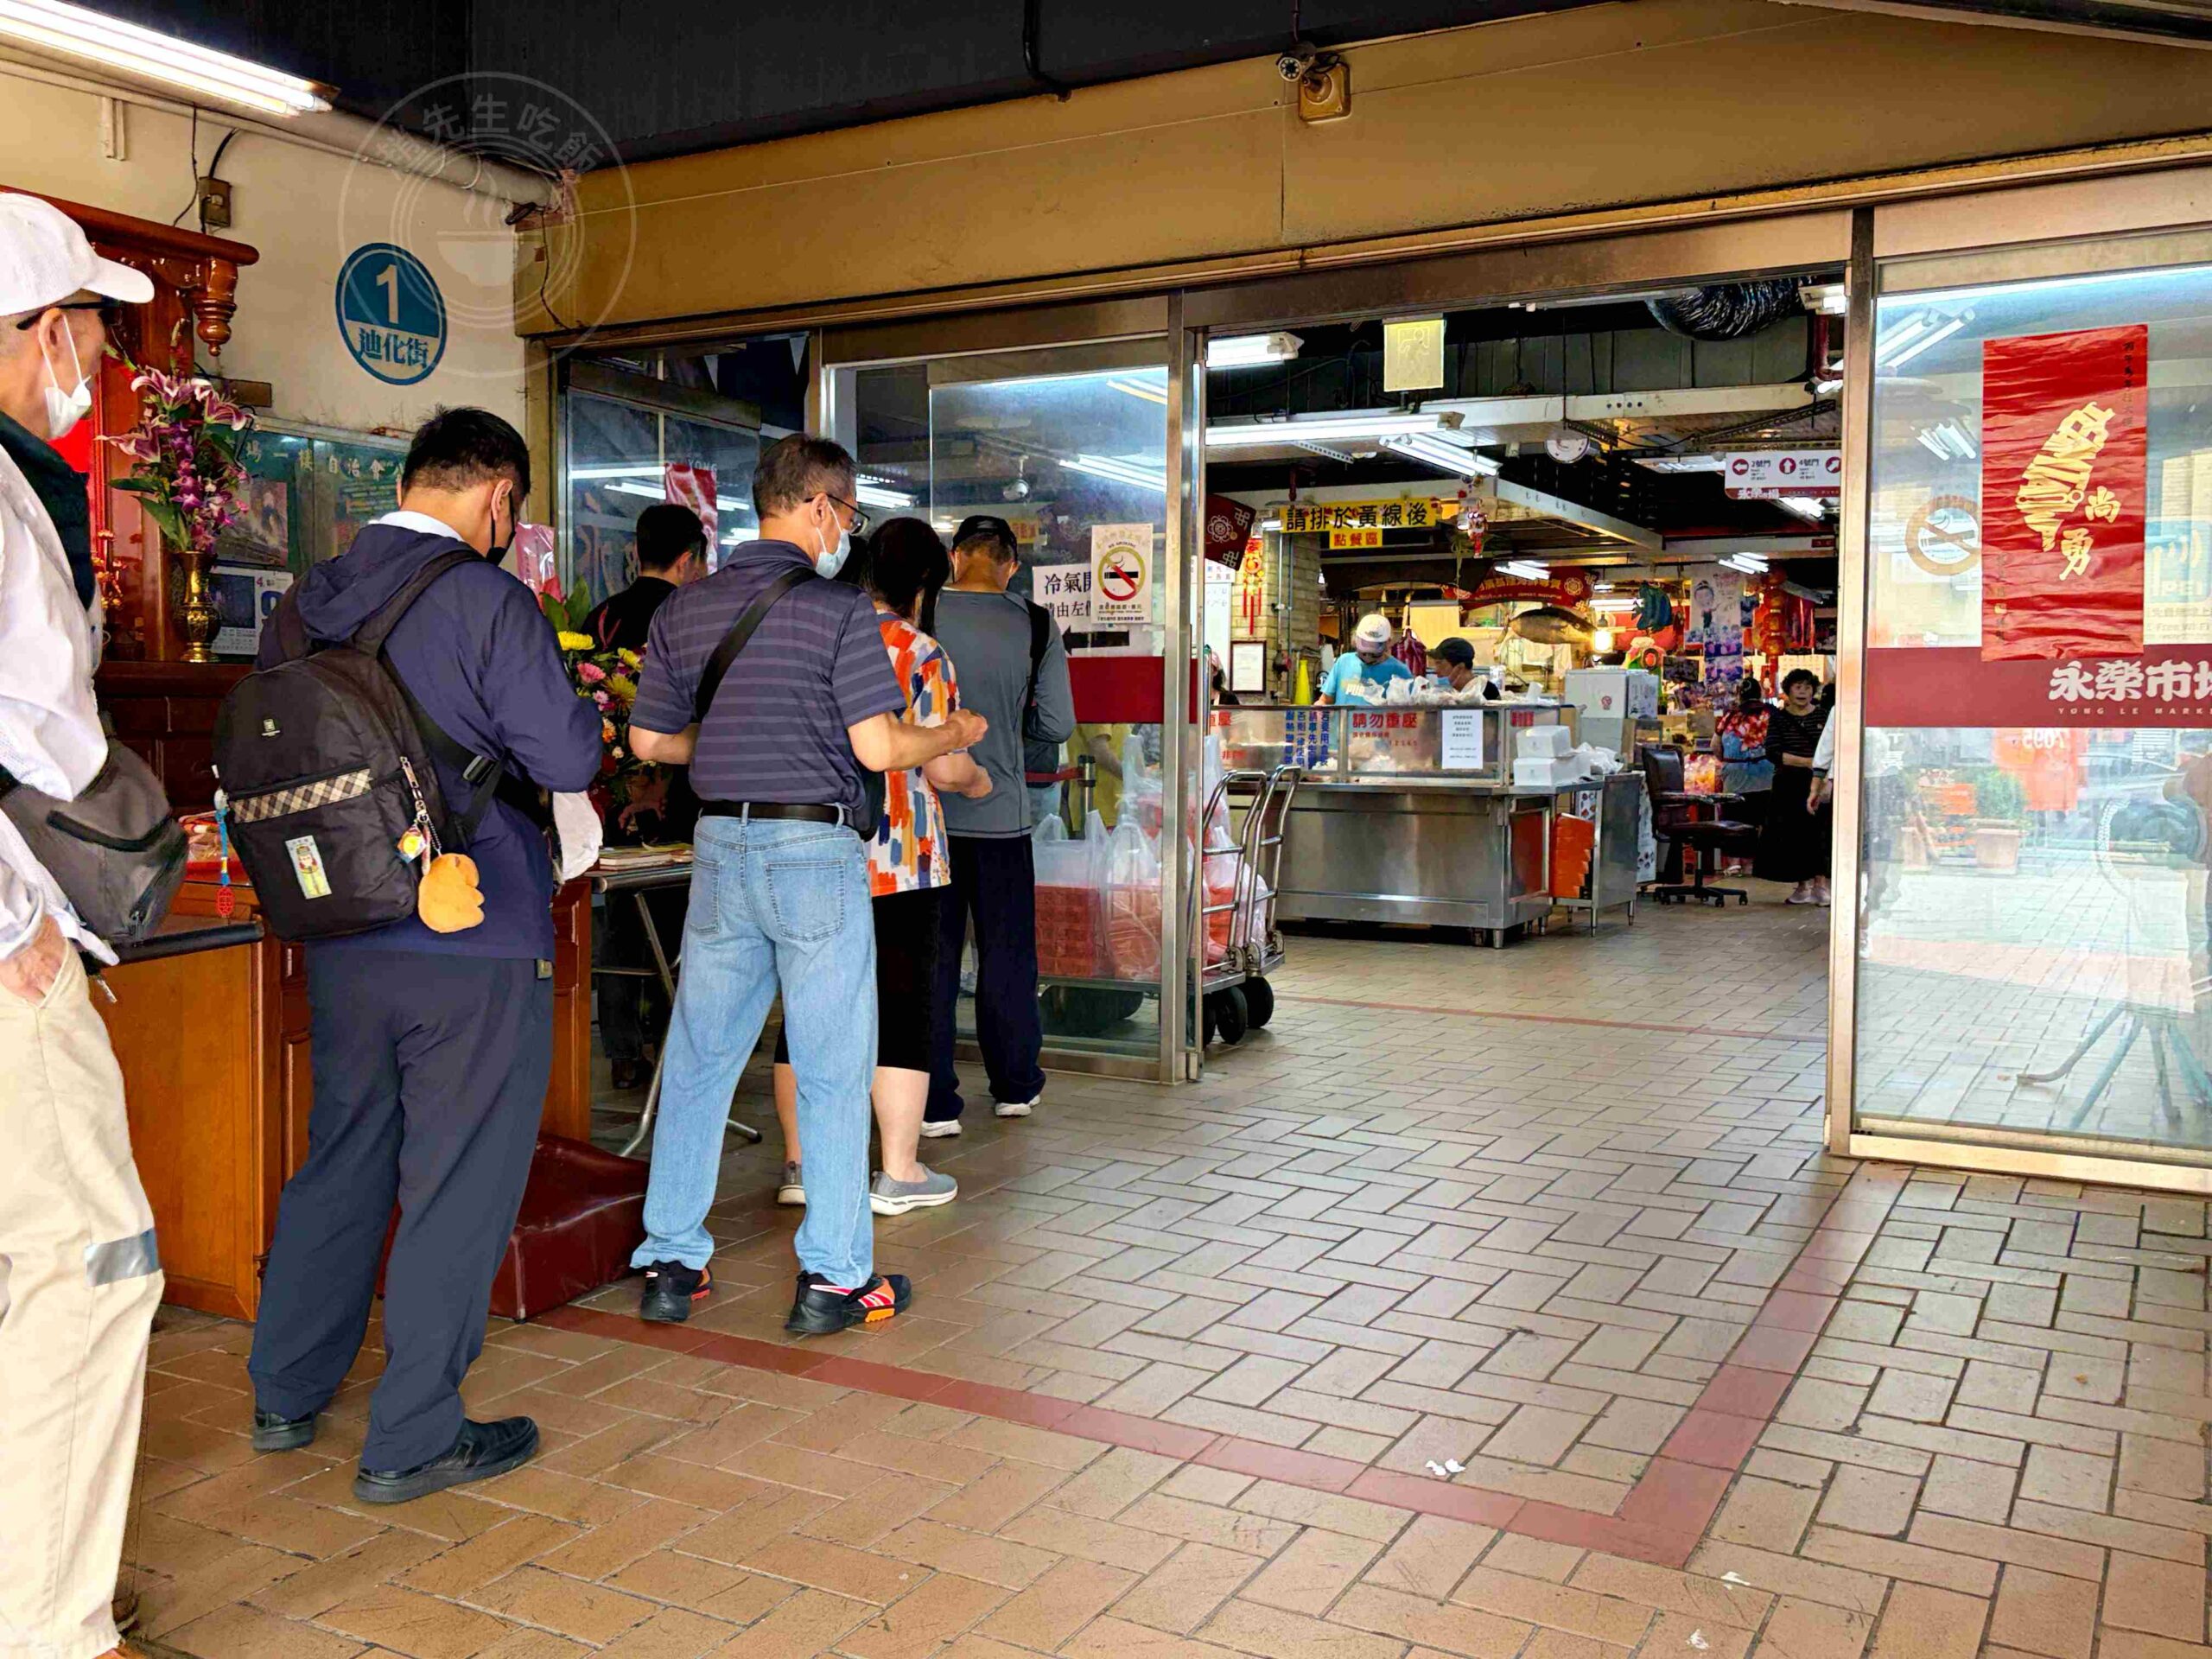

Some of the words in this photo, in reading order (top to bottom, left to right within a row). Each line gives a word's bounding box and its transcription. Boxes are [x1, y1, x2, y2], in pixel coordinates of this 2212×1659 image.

[376, 264, 398, 324] 1
[358, 327, 429, 370] 迪化街
[1287, 502, 1427, 531] 請排於黃線後
[1333, 531, 1378, 547] 點餐區
[1352, 712, 1418, 728] 請勿重壓
